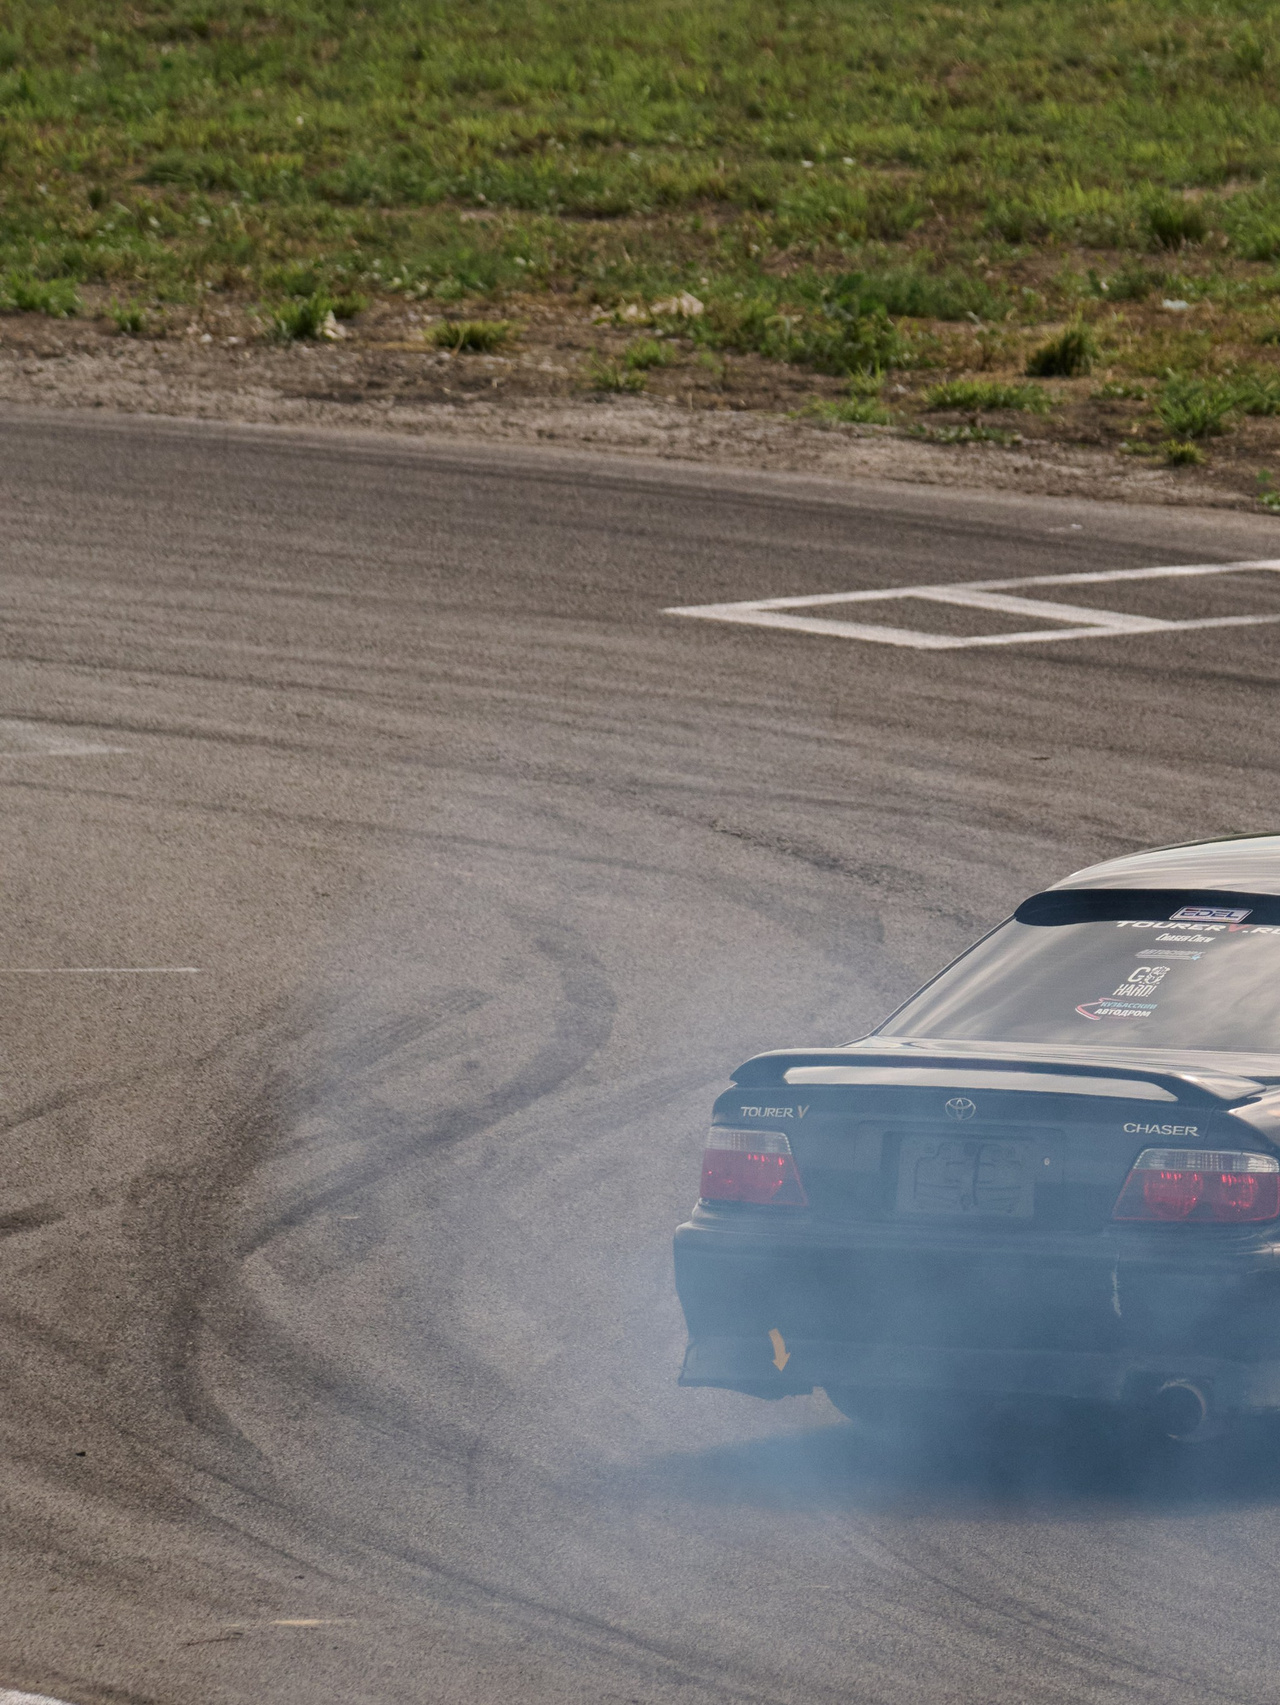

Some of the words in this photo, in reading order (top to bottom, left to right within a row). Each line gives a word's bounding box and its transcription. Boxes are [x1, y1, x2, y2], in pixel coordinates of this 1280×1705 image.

[1180, 908, 1239, 919] EDEL
[1112, 983, 1157, 998] HARD!
[1094, 1008, 1151, 1017] АВТОДРОМ
[740, 1106, 794, 1119] TOURER
[797, 1105, 809, 1119] V
[1123, 1122, 1200, 1137] CHASER
